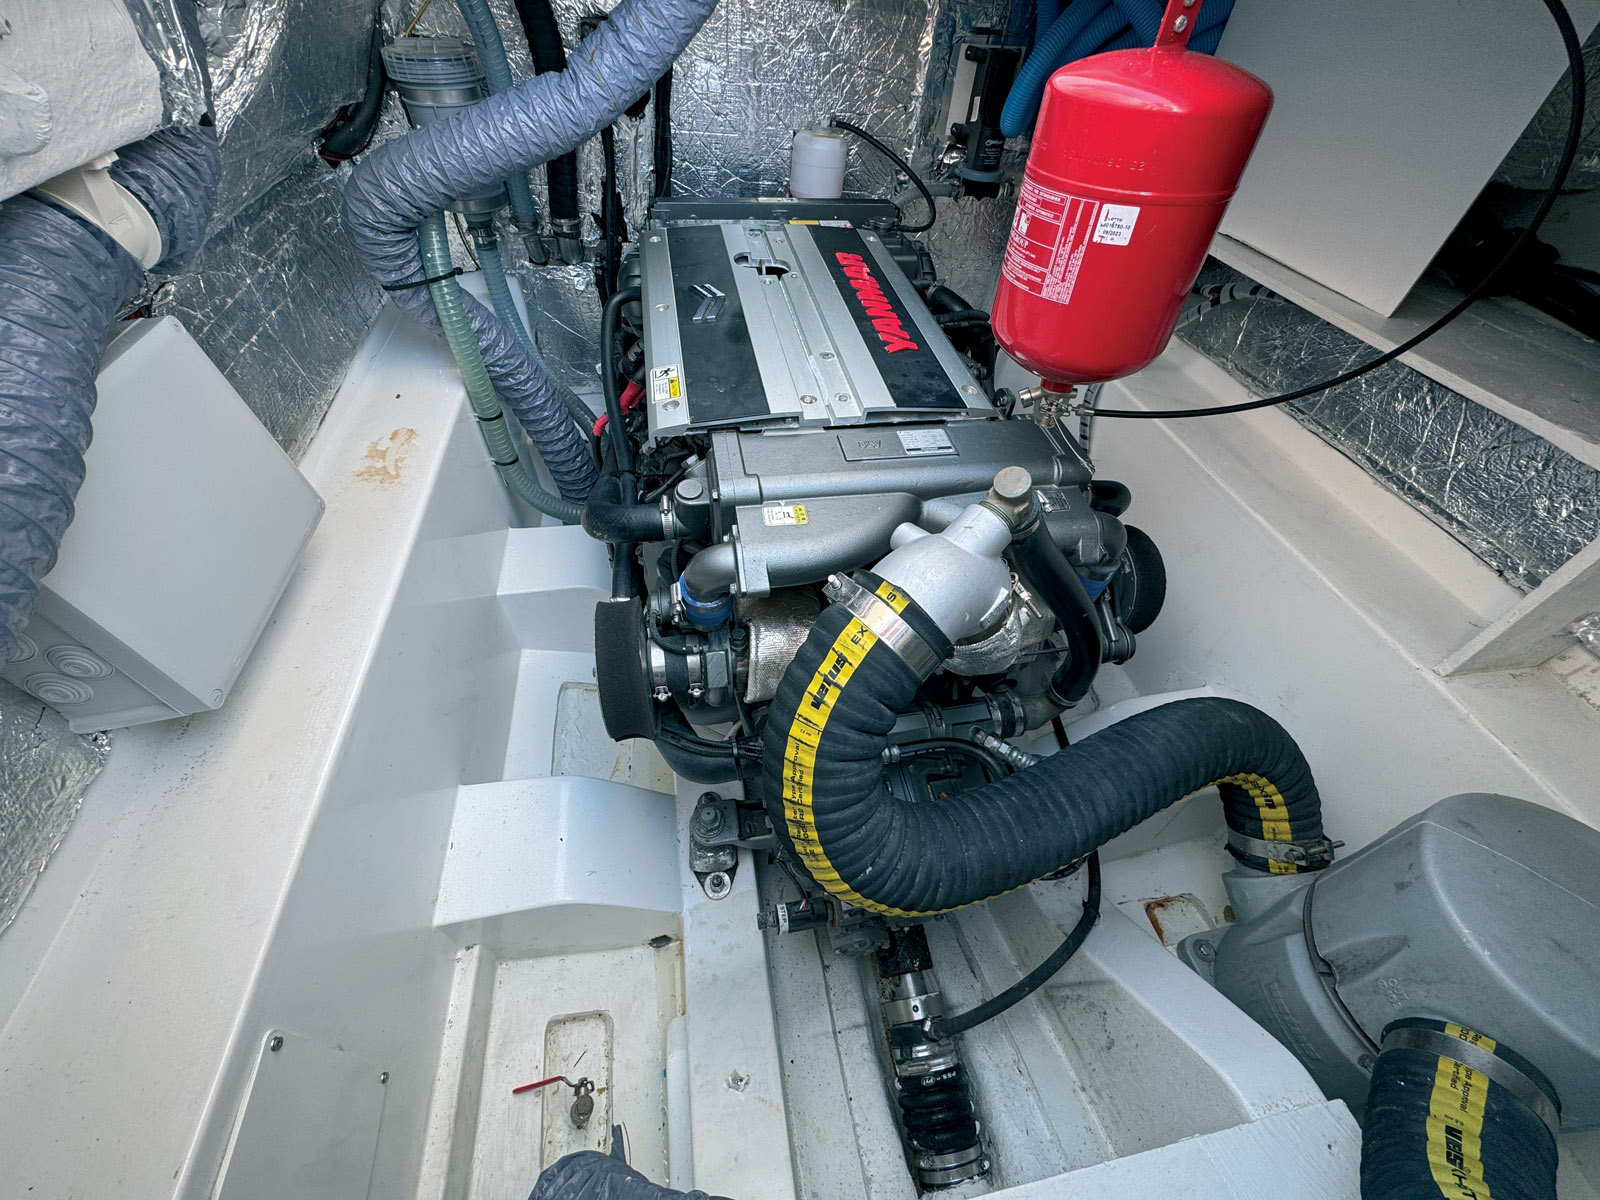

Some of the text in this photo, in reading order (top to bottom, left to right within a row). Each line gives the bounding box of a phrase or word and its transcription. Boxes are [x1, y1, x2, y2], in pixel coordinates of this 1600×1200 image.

[835, 252, 919, 355] YANMAR
[790, 742, 800, 782] Approval
[1388, 978, 1410, 1001] OUT
[1449, 1061, 1462, 1091] ertified
